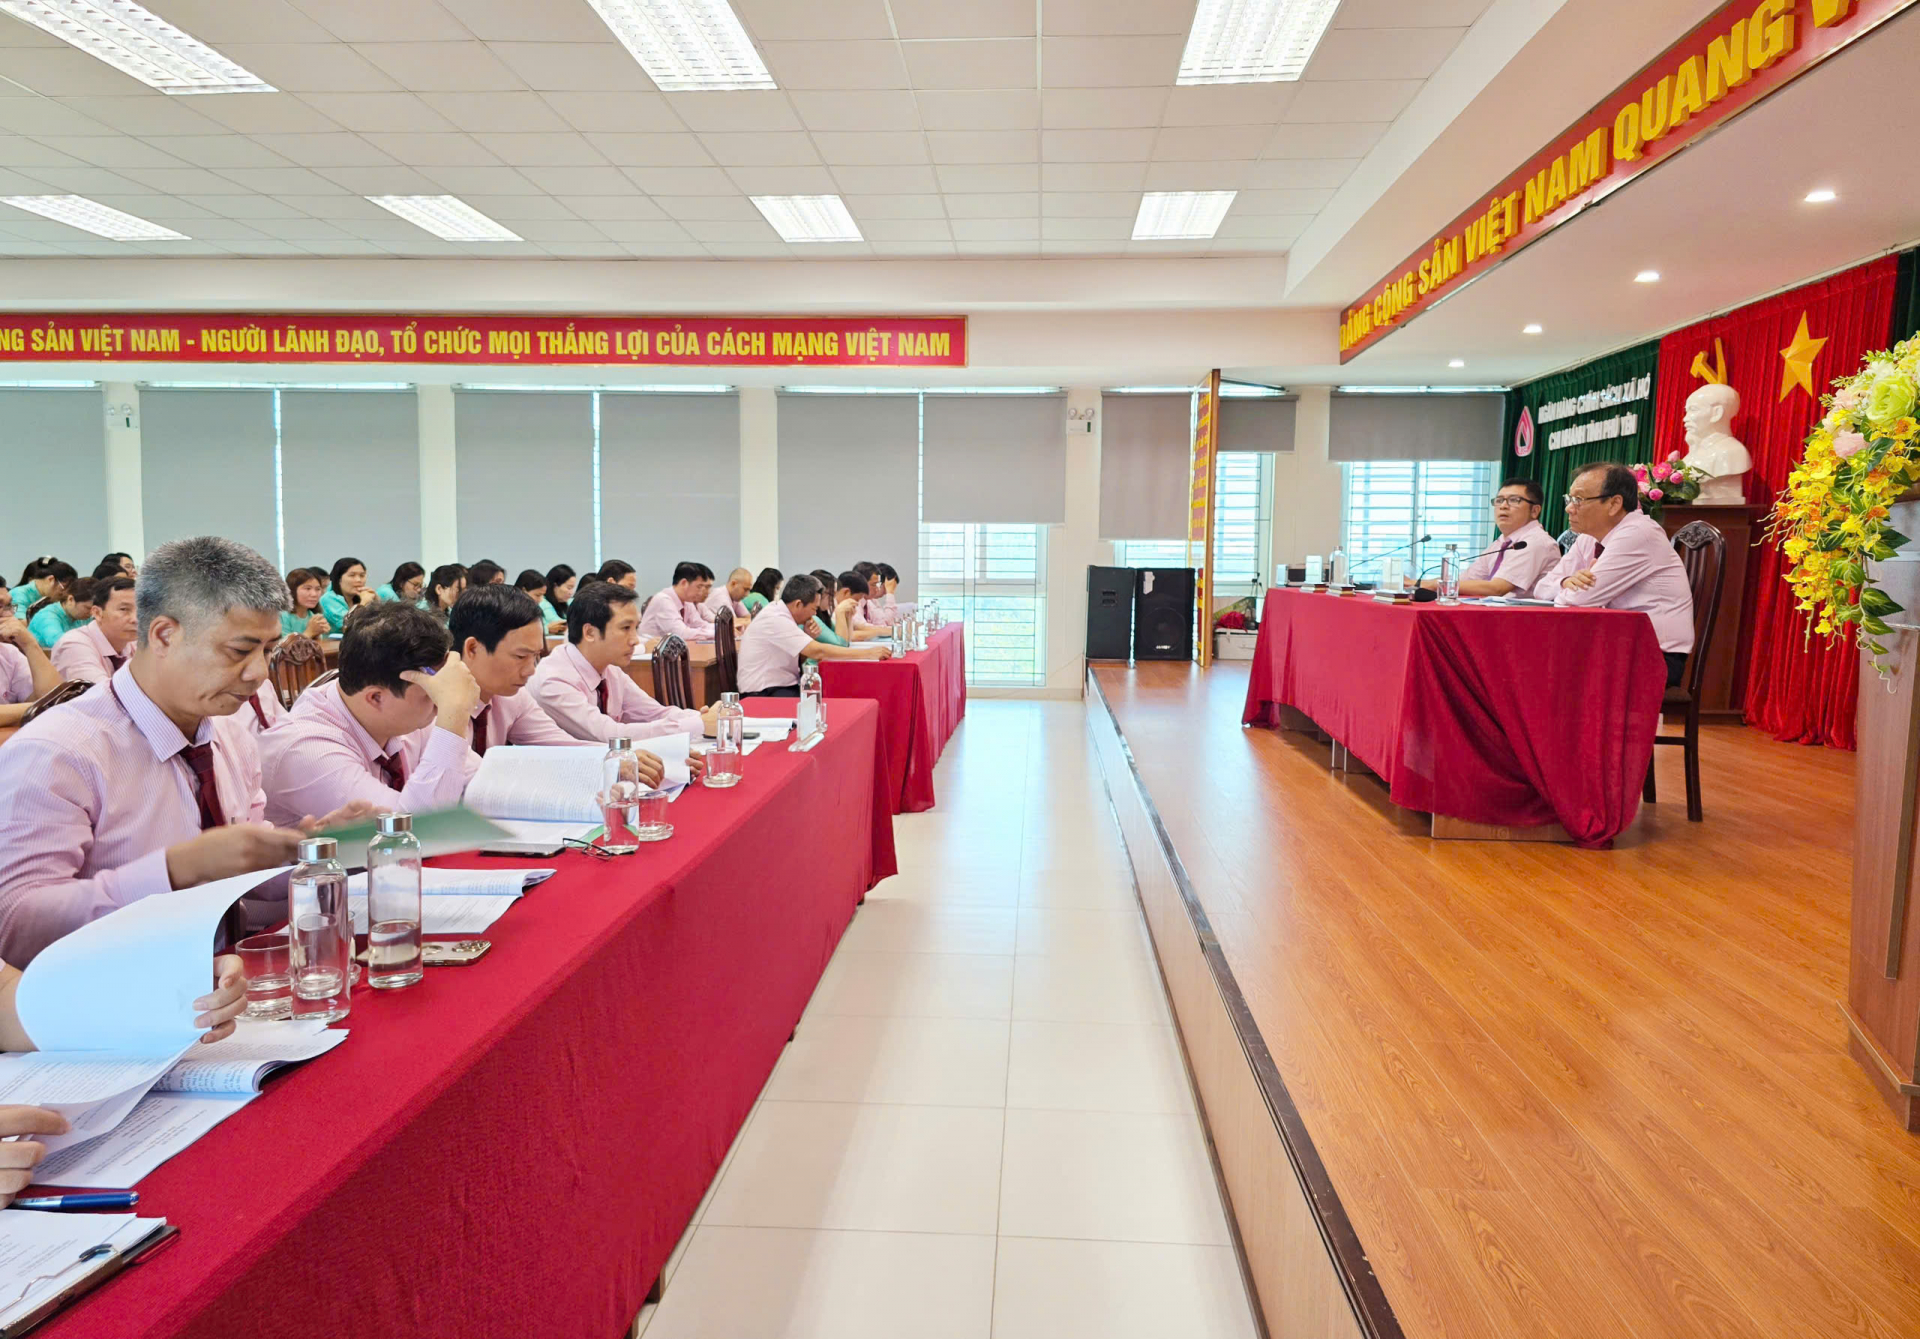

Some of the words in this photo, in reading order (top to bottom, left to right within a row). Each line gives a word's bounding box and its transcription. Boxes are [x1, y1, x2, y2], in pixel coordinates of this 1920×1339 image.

[1374, 271, 1417, 327] CỘNG
[1418, 235, 1463, 295] SẢN
[1465, 190, 1521, 264] VIỆT
[1524, 127, 1608, 225] NAM
[1613, 0, 1795, 161] QUANG
[31, 320, 75, 352] SẢN
[80, 326, 124, 358] VIỆT
[131, 328, 180, 352] NAM
[202, 324, 267, 353] NGƯỜI
[274, 325, 329, 353] LÃNH
[336, 330, 385, 359] ĐẠO,
[391, 321, 417, 354] TỔ
[425, 327, 482, 355] CHỨC
[489, 331, 531, 360] MỌI
[538, 322, 609, 355] THẮNG
[616, 330, 649, 360] LỢI
[656, 324, 700, 356] CỦA
[707, 327, 765, 356] CÁCH
[773, 332, 839, 361] MẠNG
[845, 328, 891, 361] VIỆT
[899, 333, 950, 357] NAM
